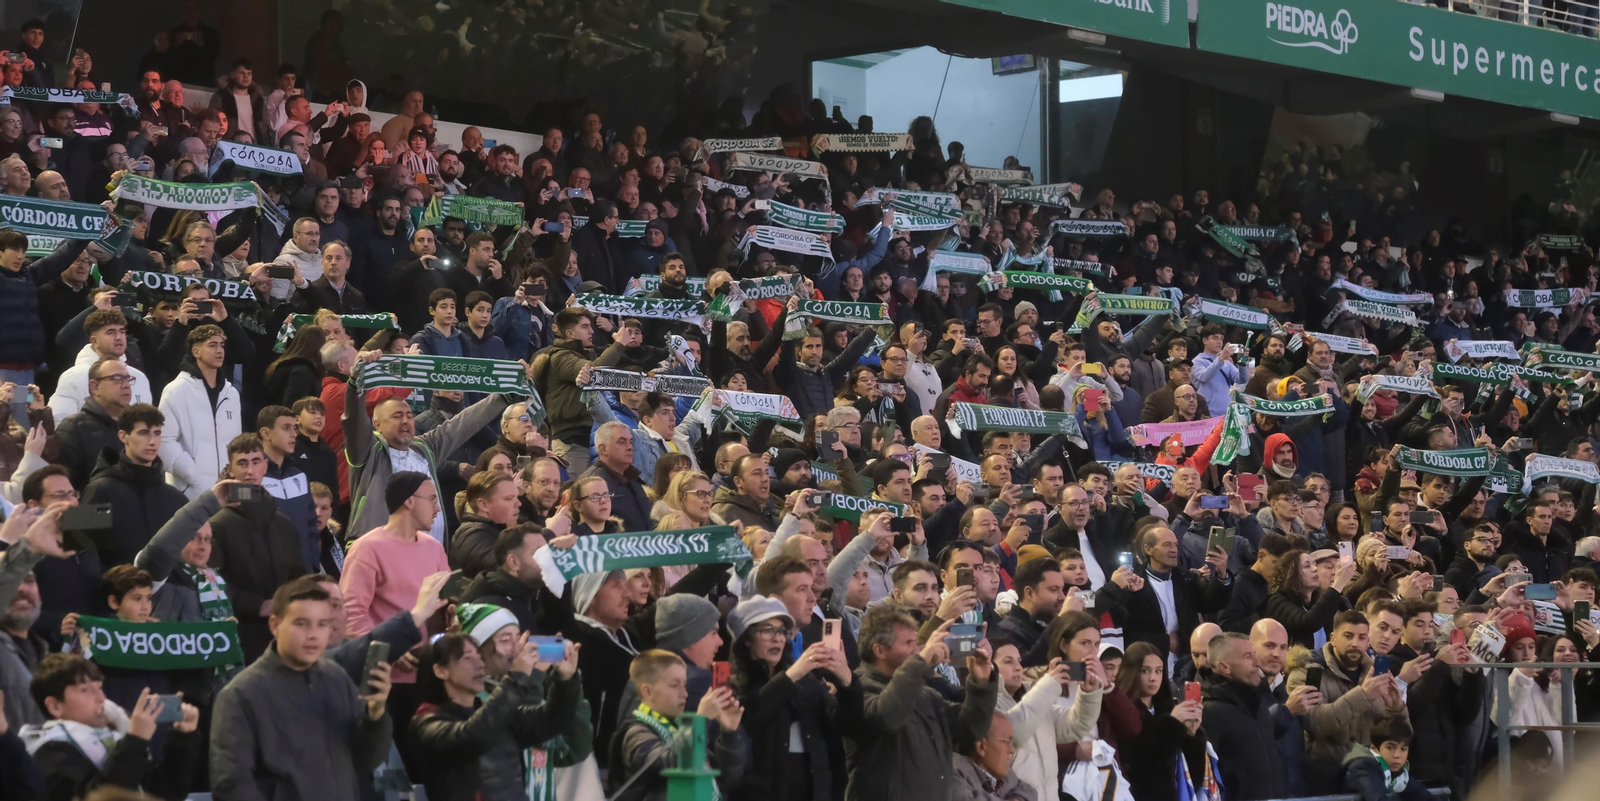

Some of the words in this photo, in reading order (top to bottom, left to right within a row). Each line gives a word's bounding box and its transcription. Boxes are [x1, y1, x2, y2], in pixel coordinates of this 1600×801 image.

[230, 146, 293, 168] CÓRDOBA
[2, 202, 78, 230] CÓRDOBA
[81, 216, 104, 231] CF
[1060, 221, 1117, 234] CÓRDOBA
[770, 231, 804, 242] CÓRDOBA
[1011, 273, 1073, 287] CÓRDOBA
[1073, 280, 1086, 290] CF
[1217, 307, 1258, 323] CÓRDOBA
[1437, 363, 1497, 380] CÓRDOBA
[735, 392, 776, 409] CÓRDOBA
[1474, 456, 1487, 469] CF
[114, 631, 230, 661] CÓRDOBA
